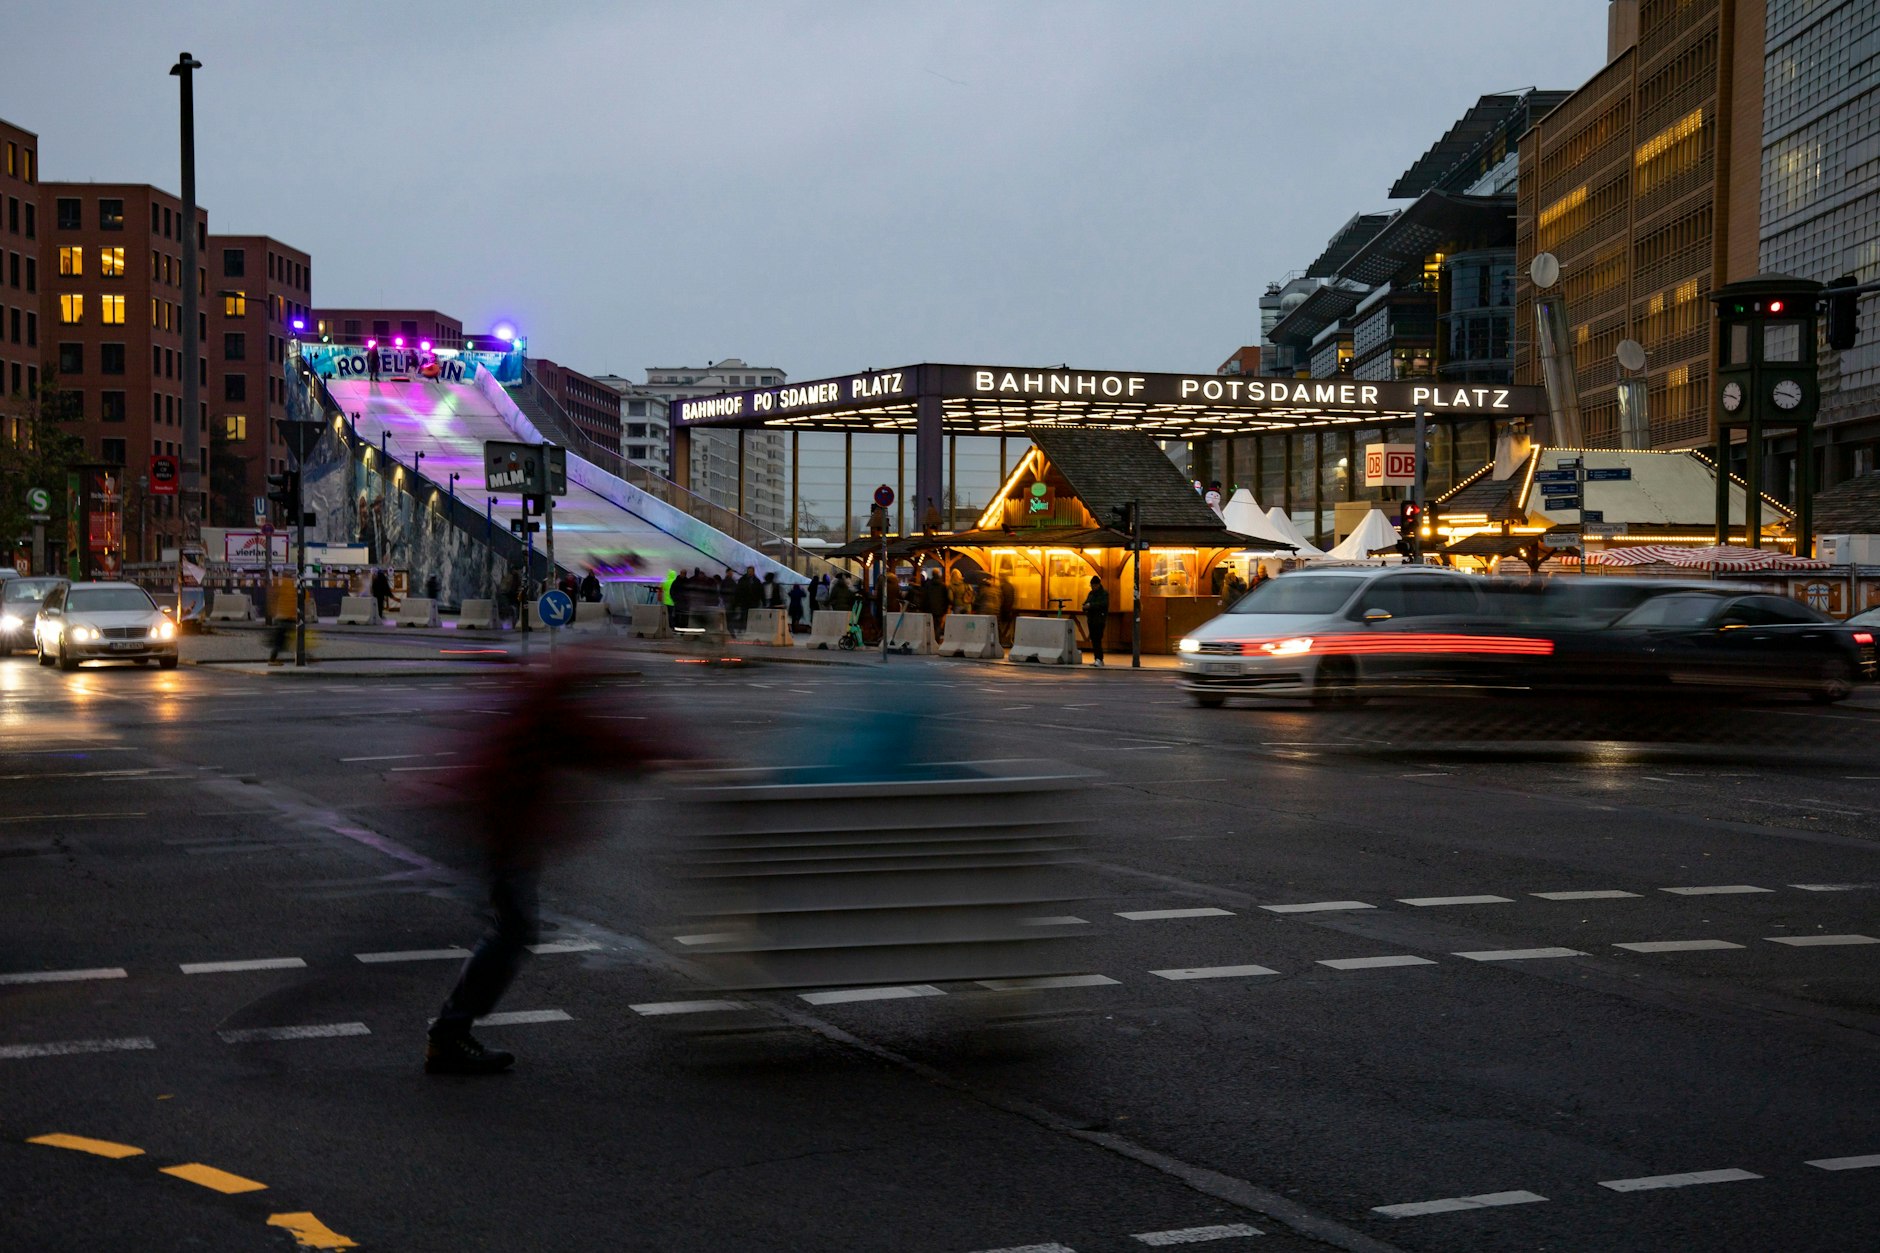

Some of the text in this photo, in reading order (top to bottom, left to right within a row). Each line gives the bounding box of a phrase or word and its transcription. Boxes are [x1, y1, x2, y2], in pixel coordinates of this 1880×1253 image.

[338, 354, 463, 382] ROELAN
[682, 373, 903, 420] BAHNHOF POTSDAMER PLATZ
[976, 371, 1509, 408] BAHNHOF POTSDAMER PLATZ
[1369, 456, 1381, 474] DB
[1391, 456, 1416, 474] DB
[33, 489, 47, 511] S
[257, 498, 265, 514] U
[236, 549, 279, 557] vierlane
